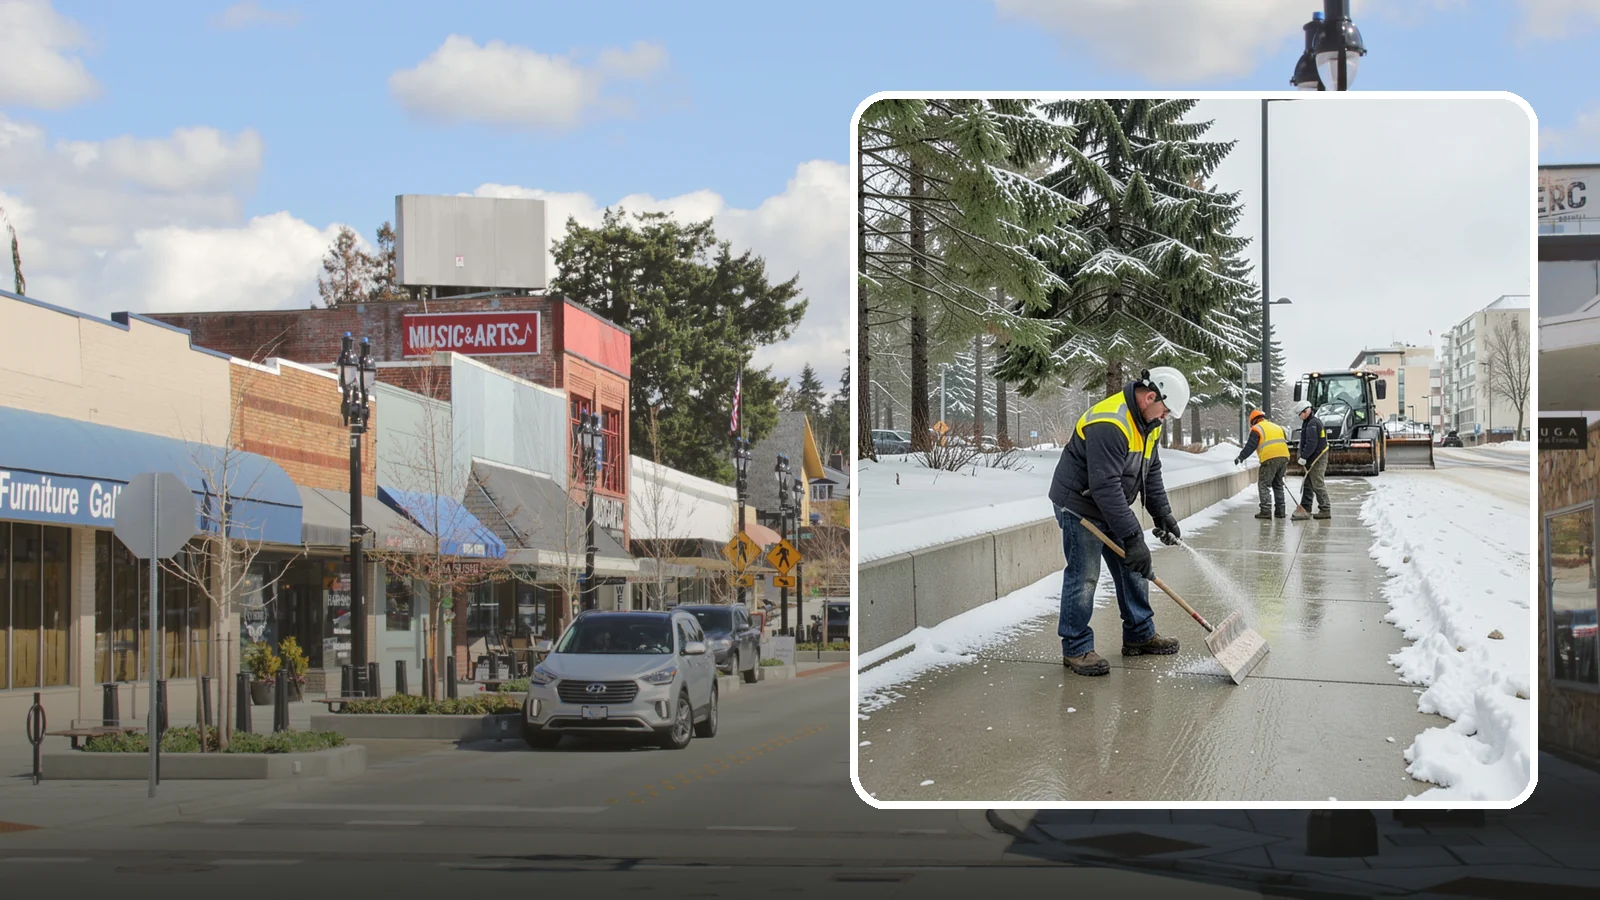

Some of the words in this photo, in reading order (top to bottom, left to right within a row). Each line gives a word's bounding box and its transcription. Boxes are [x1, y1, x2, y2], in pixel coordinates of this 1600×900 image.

[409, 323, 519, 349] MUSIC&ARTS
[0, 471, 79, 515] Furniture
[89, 482, 121, 519] Gal
